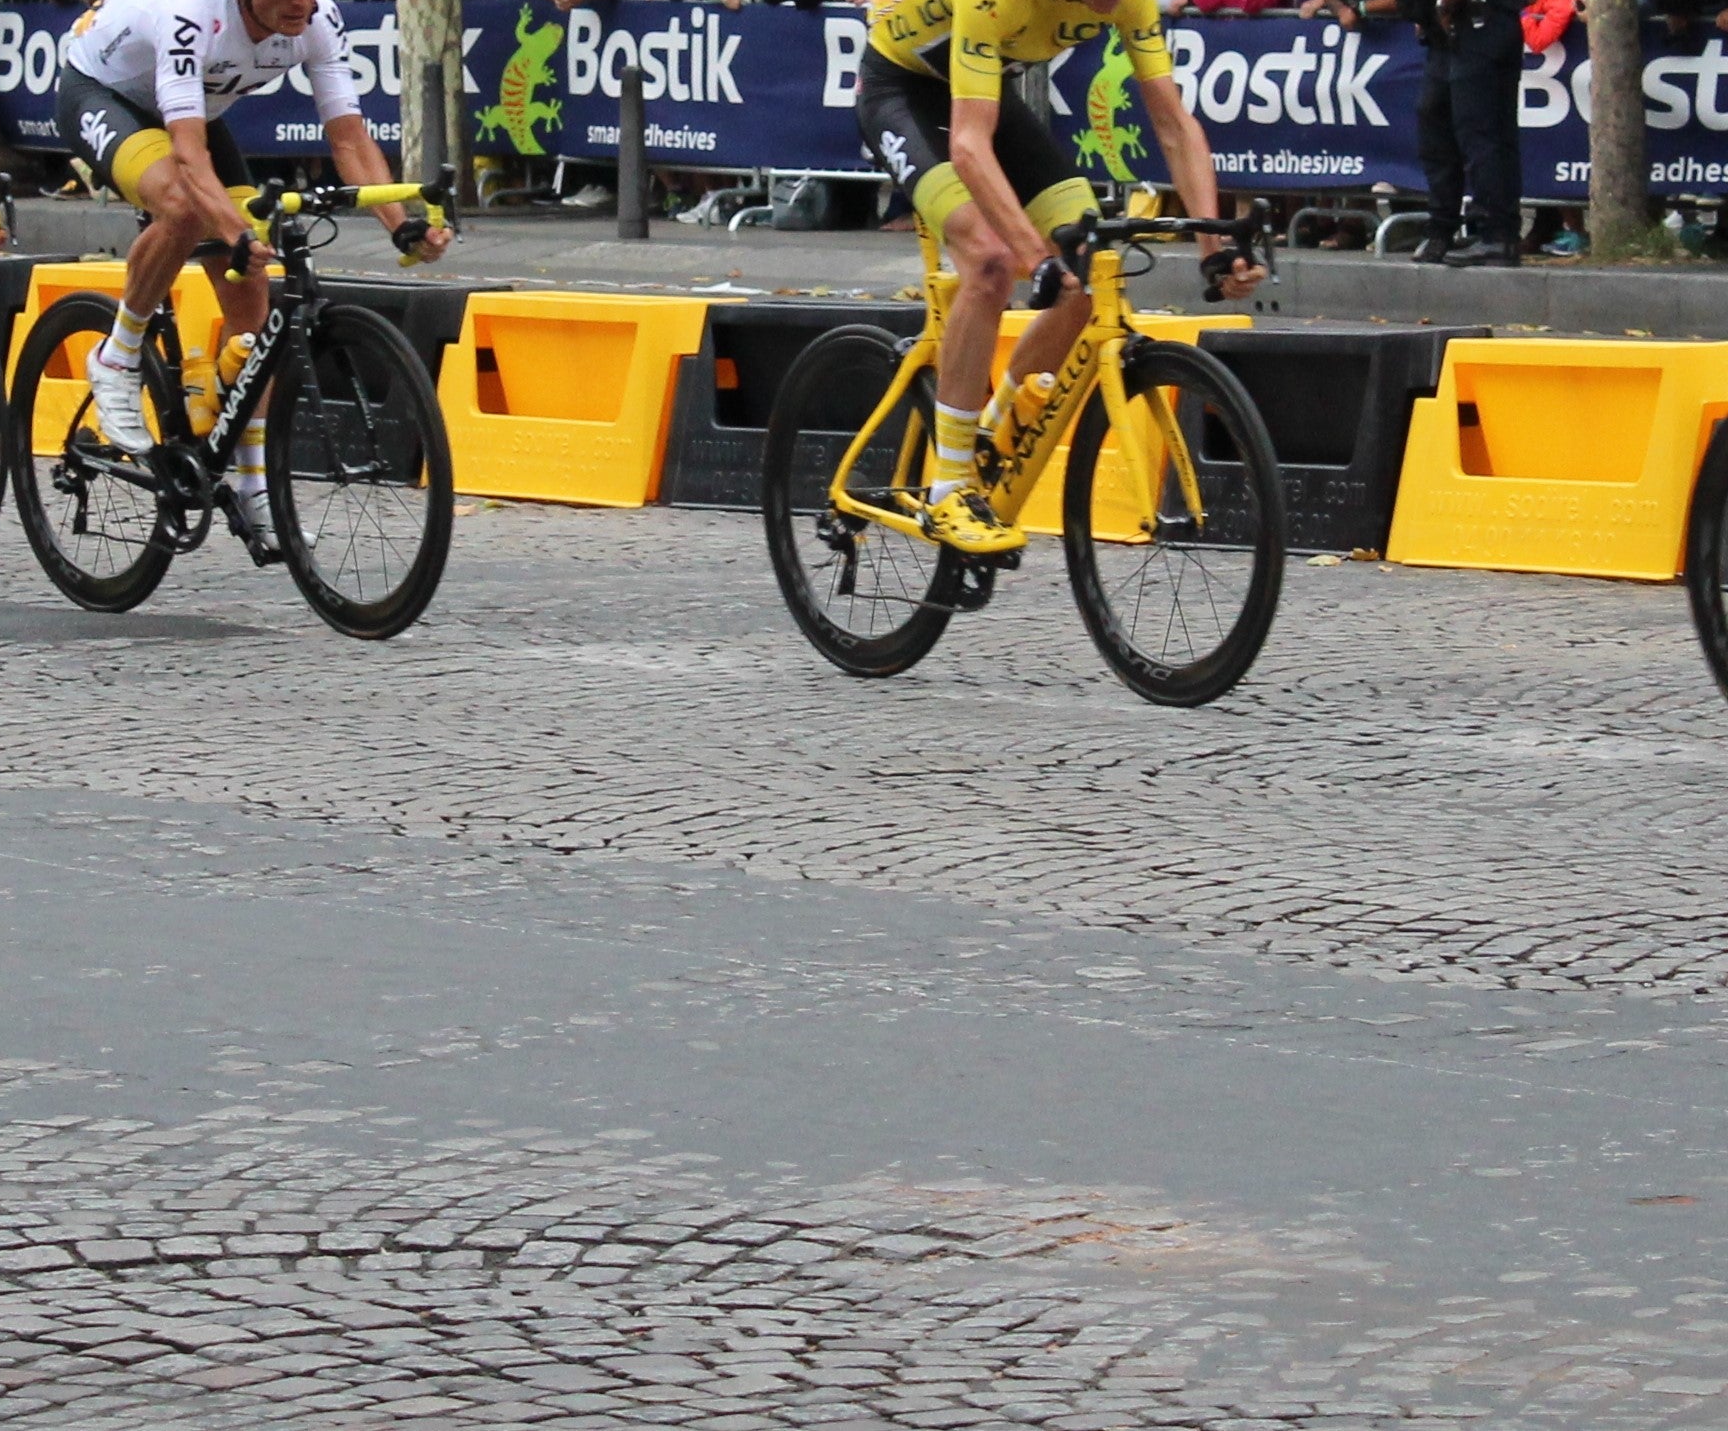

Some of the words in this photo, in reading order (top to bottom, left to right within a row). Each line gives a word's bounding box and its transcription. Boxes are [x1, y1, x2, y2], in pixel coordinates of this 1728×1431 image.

[567, 6, 744, 105] Bostik
[1166, 23, 1391, 128] Bostik
[275, 120, 325, 143] smar
[587, 124, 621, 146] smar
[643, 120, 717, 152] dhesives
[1210, 149, 1259, 174] mart
[1261, 147, 1365, 176] adhesives
[207, 306, 284, 455] PINARELLO
